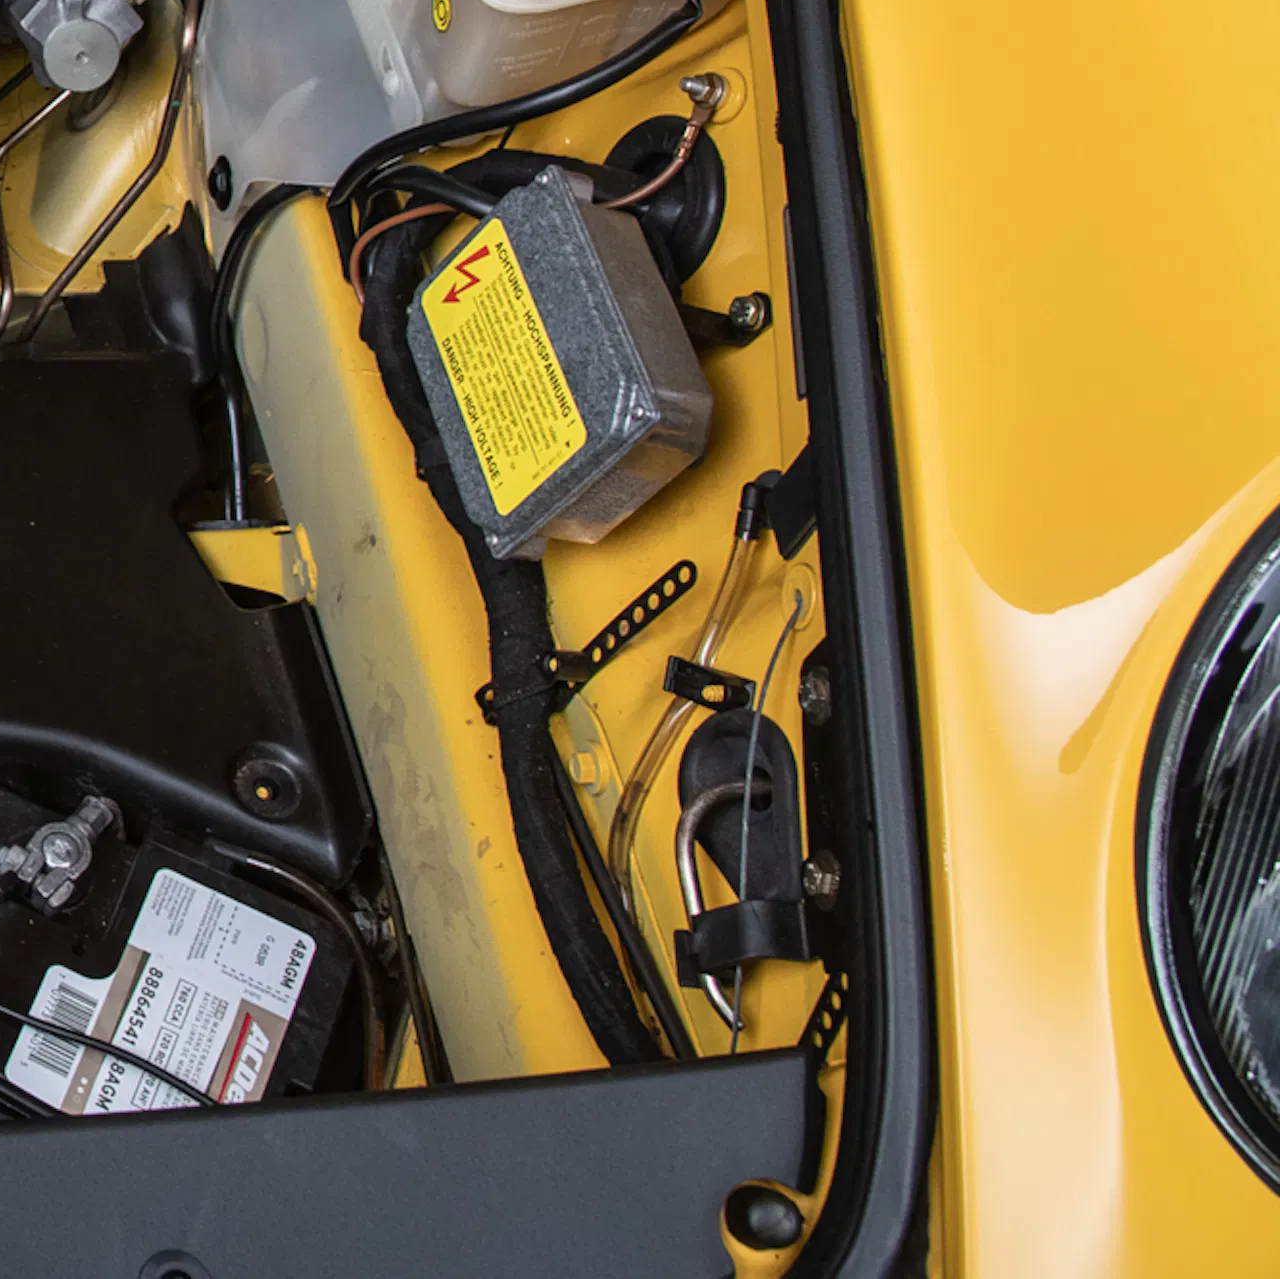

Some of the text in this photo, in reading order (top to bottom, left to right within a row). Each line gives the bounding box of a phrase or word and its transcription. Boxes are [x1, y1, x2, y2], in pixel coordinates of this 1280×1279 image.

[496, 241, 523, 301] ACHTUNG
[524, 311, 570, 419] HOCHSPANNUNG
[442, 337, 465, 386] DANGER
[463, 393, 478, 424] HIGH
[474, 426, 500, 480] VOLTAGE
[281, 938, 308, 990] 48AGM
[96, 966, 163, 1112] 88864541 8AGM
[170, 984, 190, 1023] 760 CCA
[154, 1032, 172, 1065] 120 RC
[190, 1019, 220, 1085] MAINTENANCE
[224, 1023, 271, 1102] ACDe
